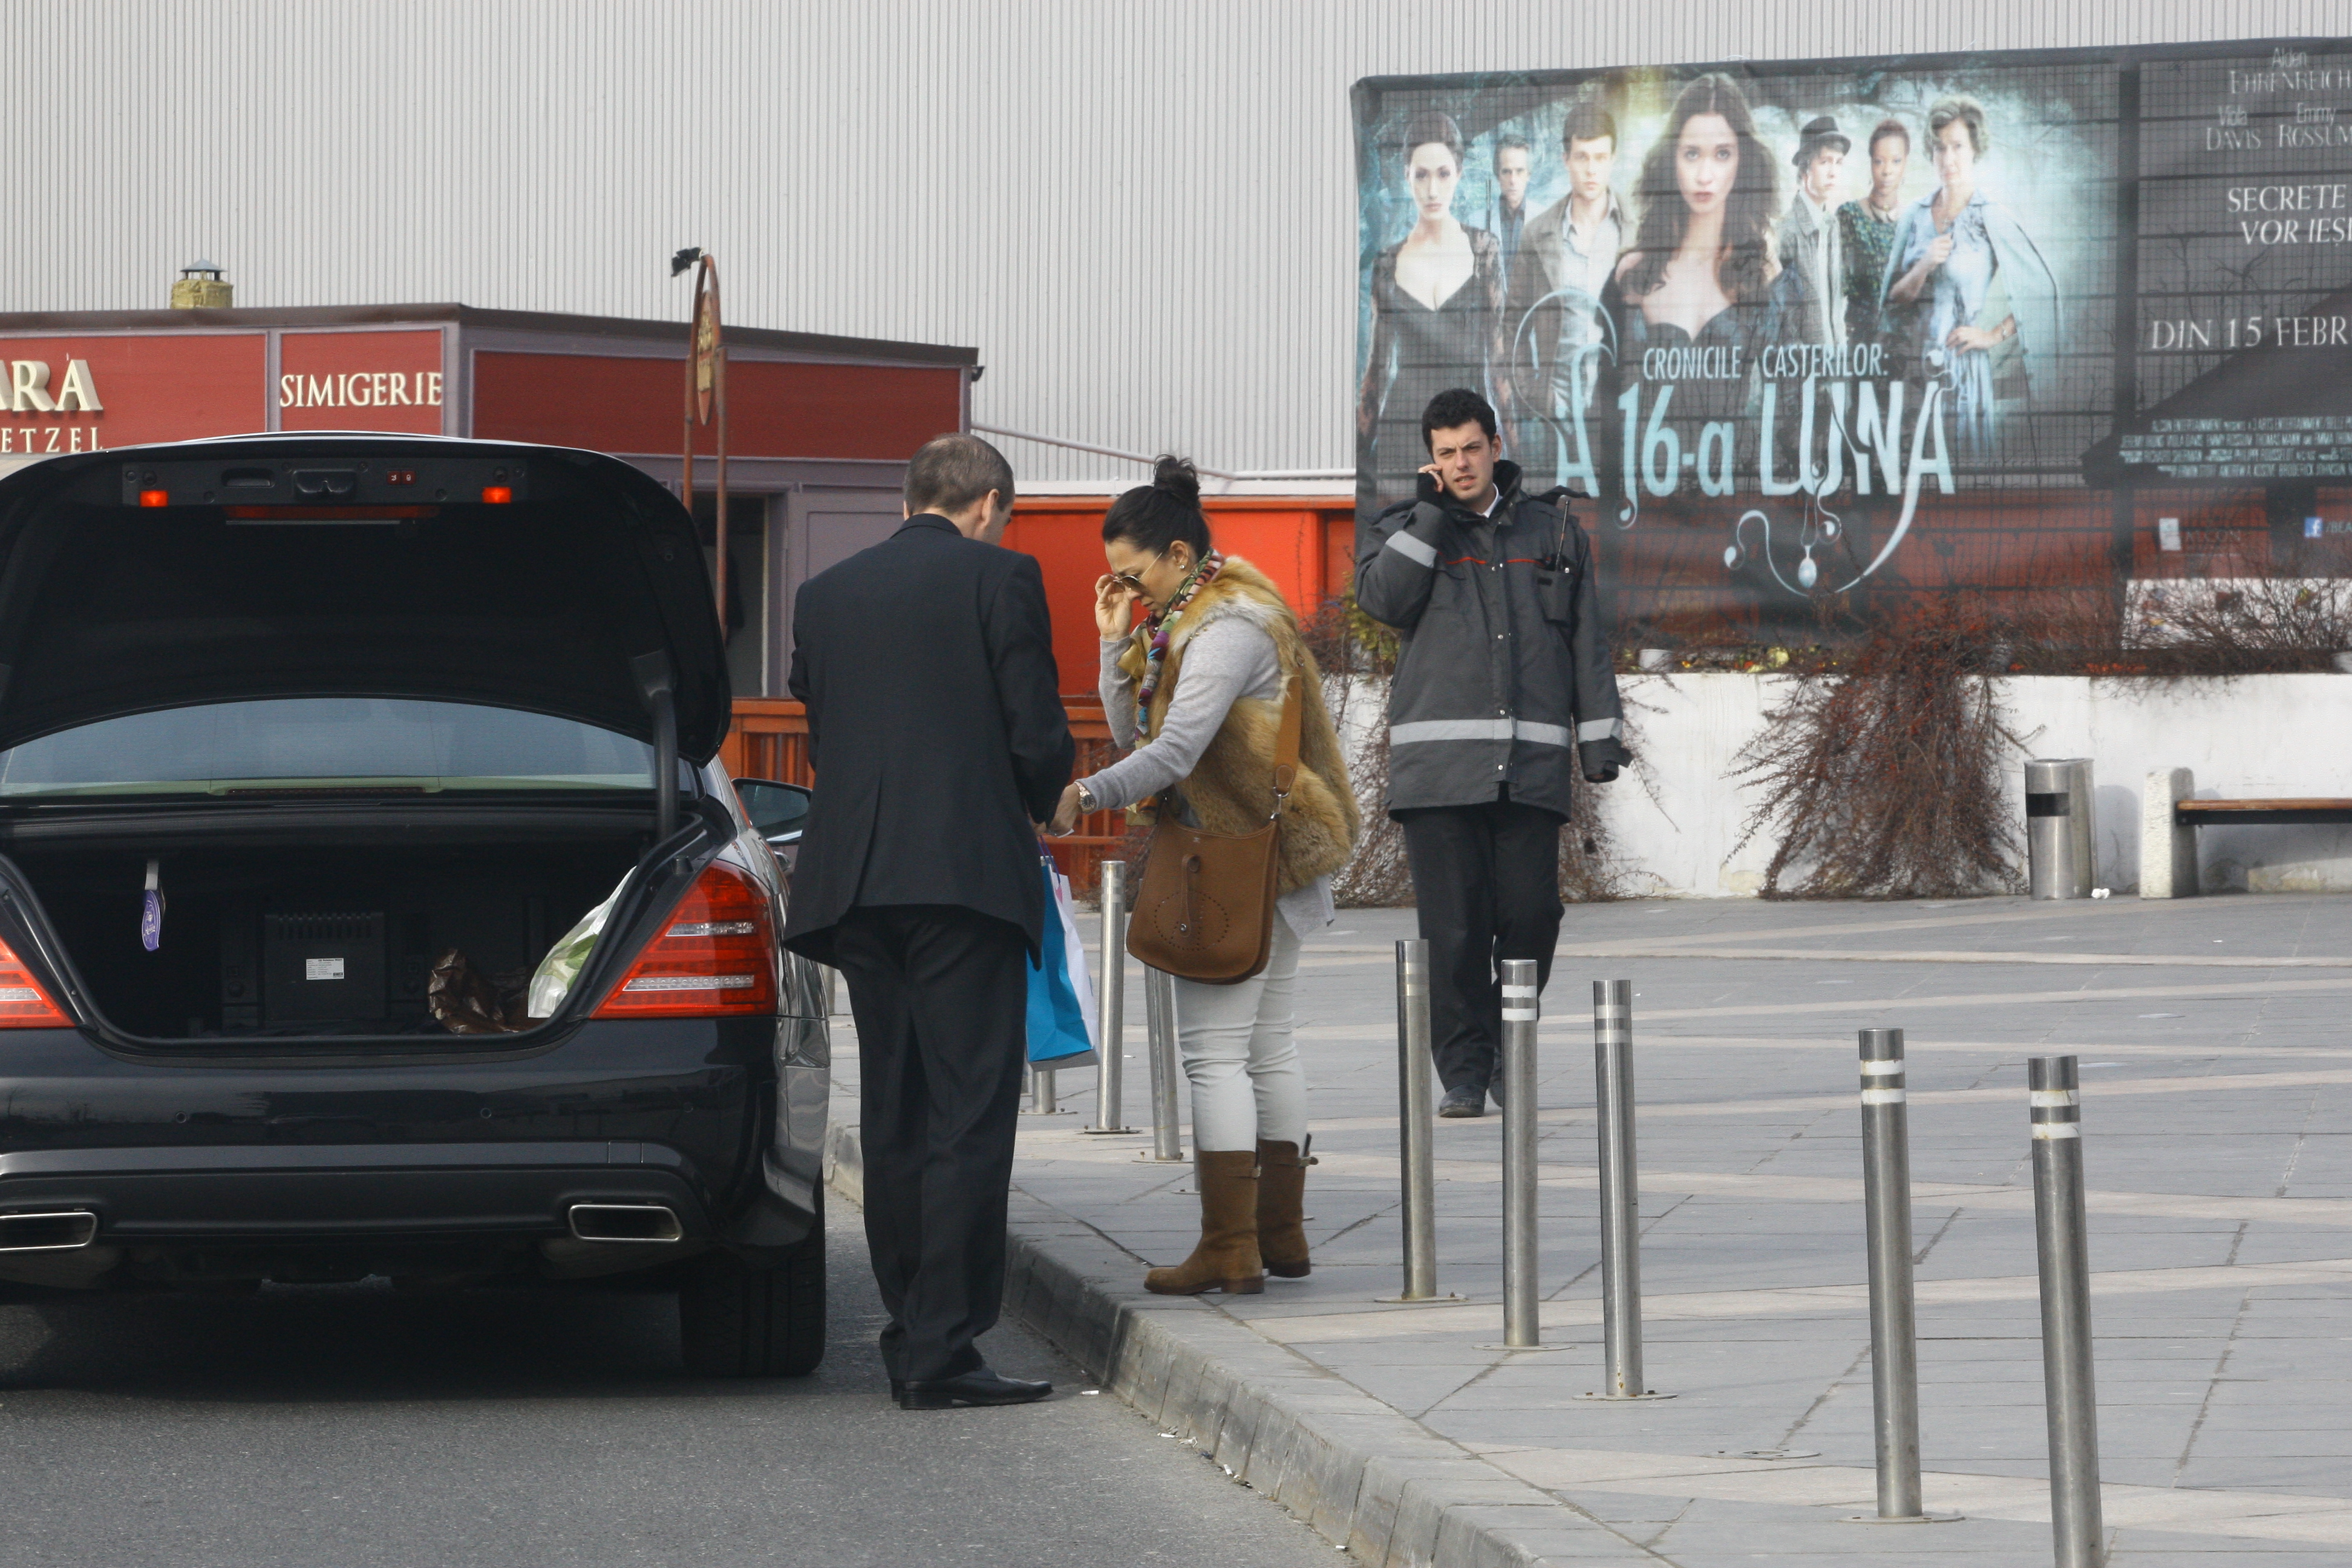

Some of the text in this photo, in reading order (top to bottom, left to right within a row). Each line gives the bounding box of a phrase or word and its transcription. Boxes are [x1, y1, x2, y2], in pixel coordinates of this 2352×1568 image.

[2229, 70, 2351, 93] EHRENREICH
[2296, 103, 2336, 126] Emmy
[2207, 128, 2261, 150] DAVIS
[2227, 185, 2347, 212] SECRETE
[2241, 220, 2298, 245] VOR
[2152, 319, 2213, 349] DIN
[2229, 316, 2262, 348] 15
[1643, 343, 1889, 380] CRONICILE CASTERILOR:
[279, 371, 442, 408] SIMIGERIE
[1616, 382, 1736, 526] 16-a
[1757, 370, 1959, 525] LUNA
